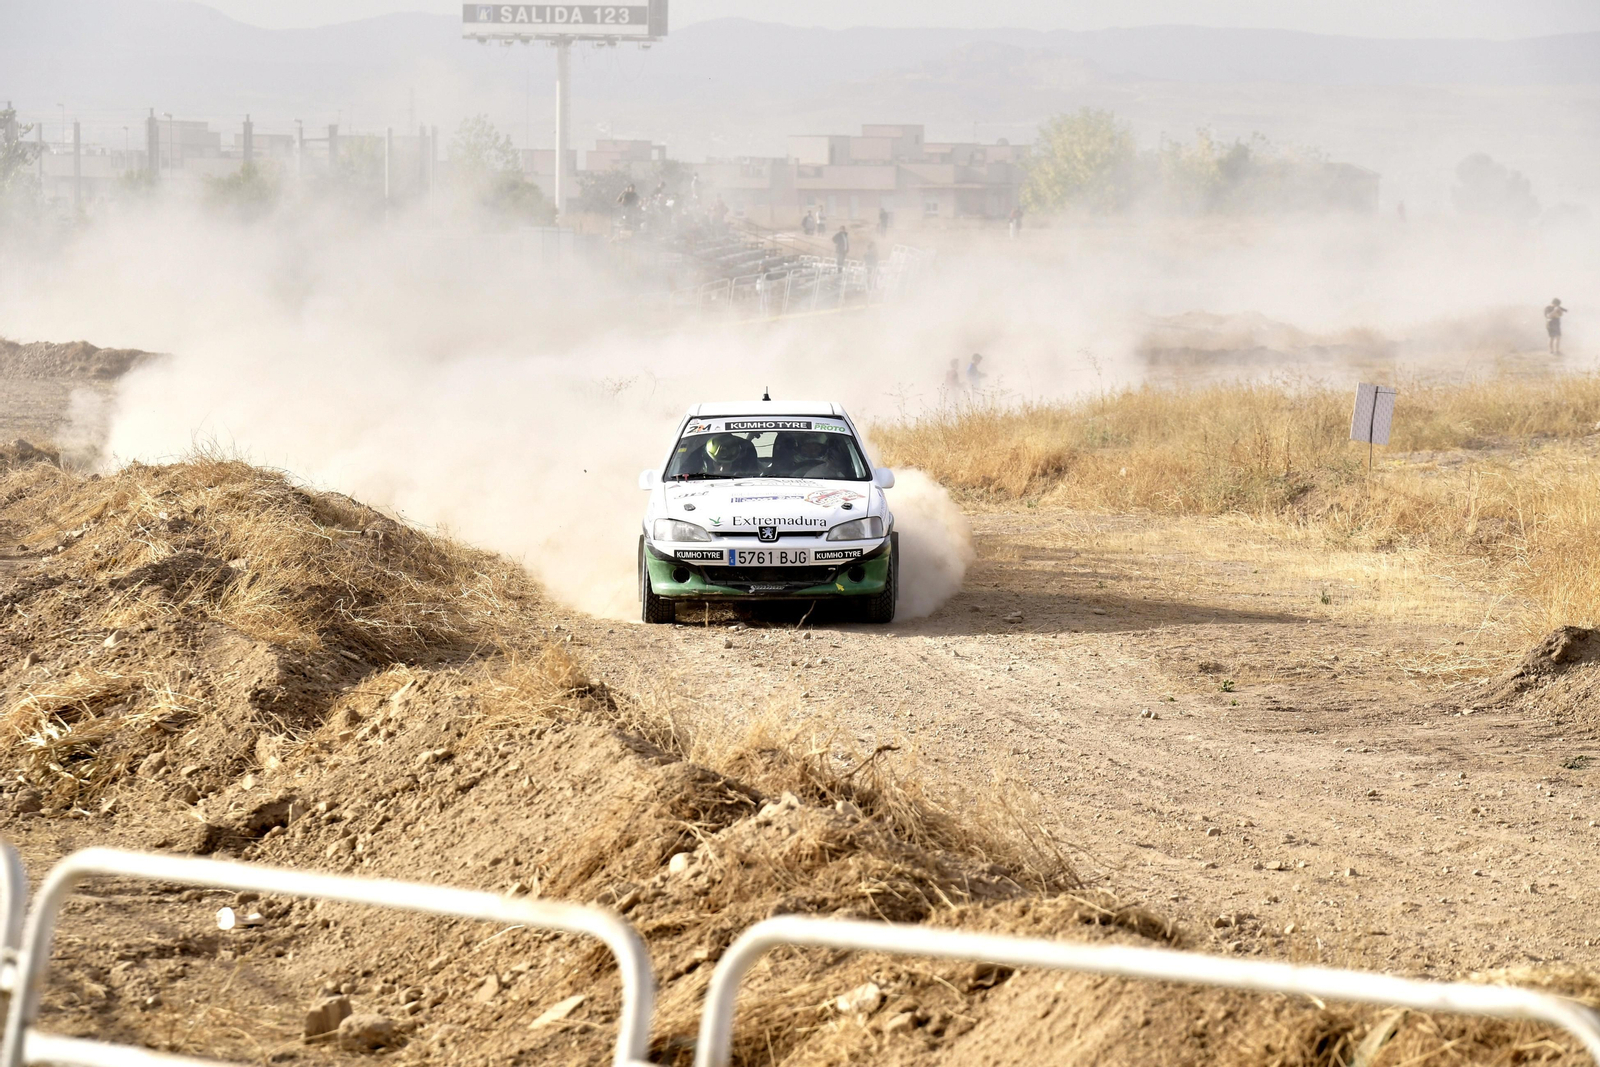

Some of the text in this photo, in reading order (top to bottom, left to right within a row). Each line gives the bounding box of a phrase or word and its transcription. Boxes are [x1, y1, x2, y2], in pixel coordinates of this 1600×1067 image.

[501, 6, 631, 24] SALIDA 123
[777, 421, 808, 429] TYRE
[814, 424, 846, 433] PROTO
[732, 515, 827, 527] Extremadura
[676, 551, 721, 559] KUMHO TYRE
[738, 551, 807, 565] 5761 BJG
[816, 550, 862, 559] KUMHO TYRE
